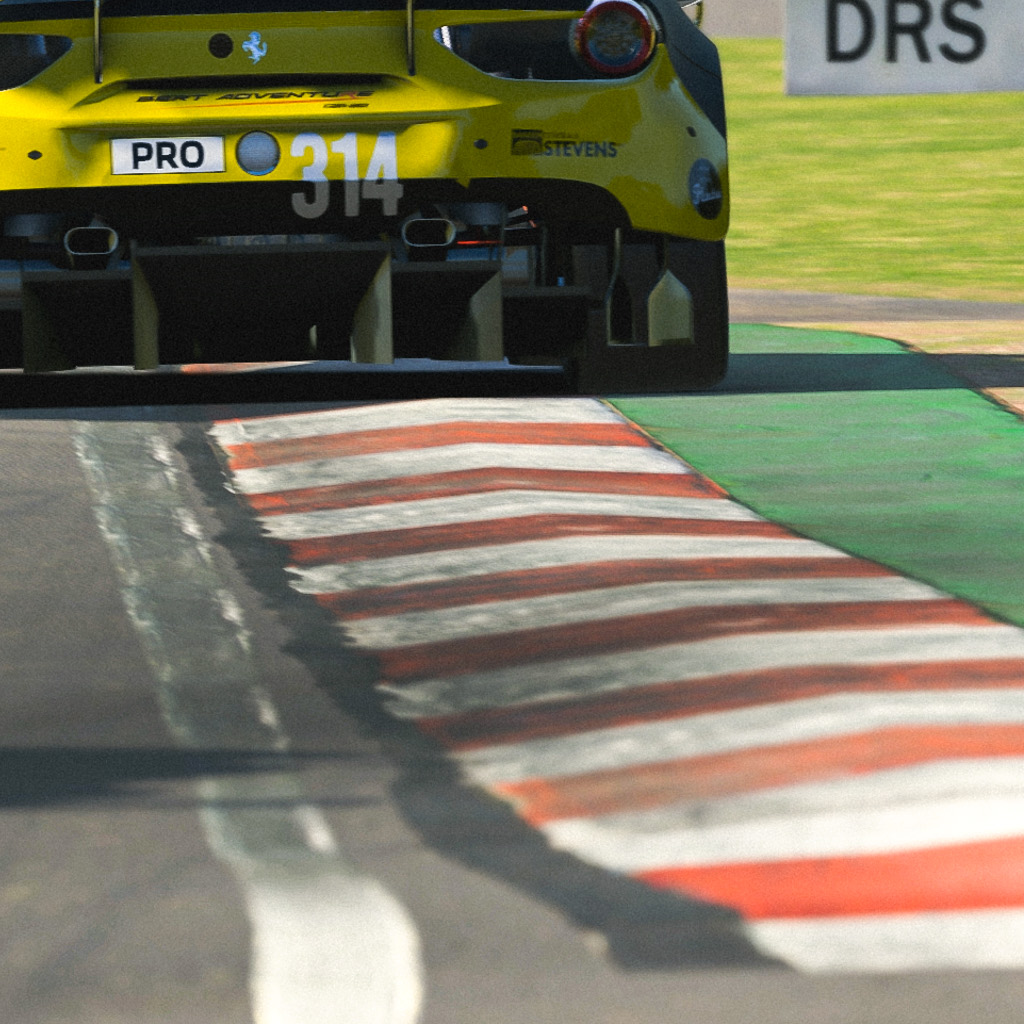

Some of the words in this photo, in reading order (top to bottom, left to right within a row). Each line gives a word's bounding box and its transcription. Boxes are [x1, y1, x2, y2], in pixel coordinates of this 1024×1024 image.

[216, 90, 374, 100] ADVENTURE
[132, 141, 205, 170] PRO
[543, 140, 618, 158] STEVENS
[290, 132, 404, 219] 314
